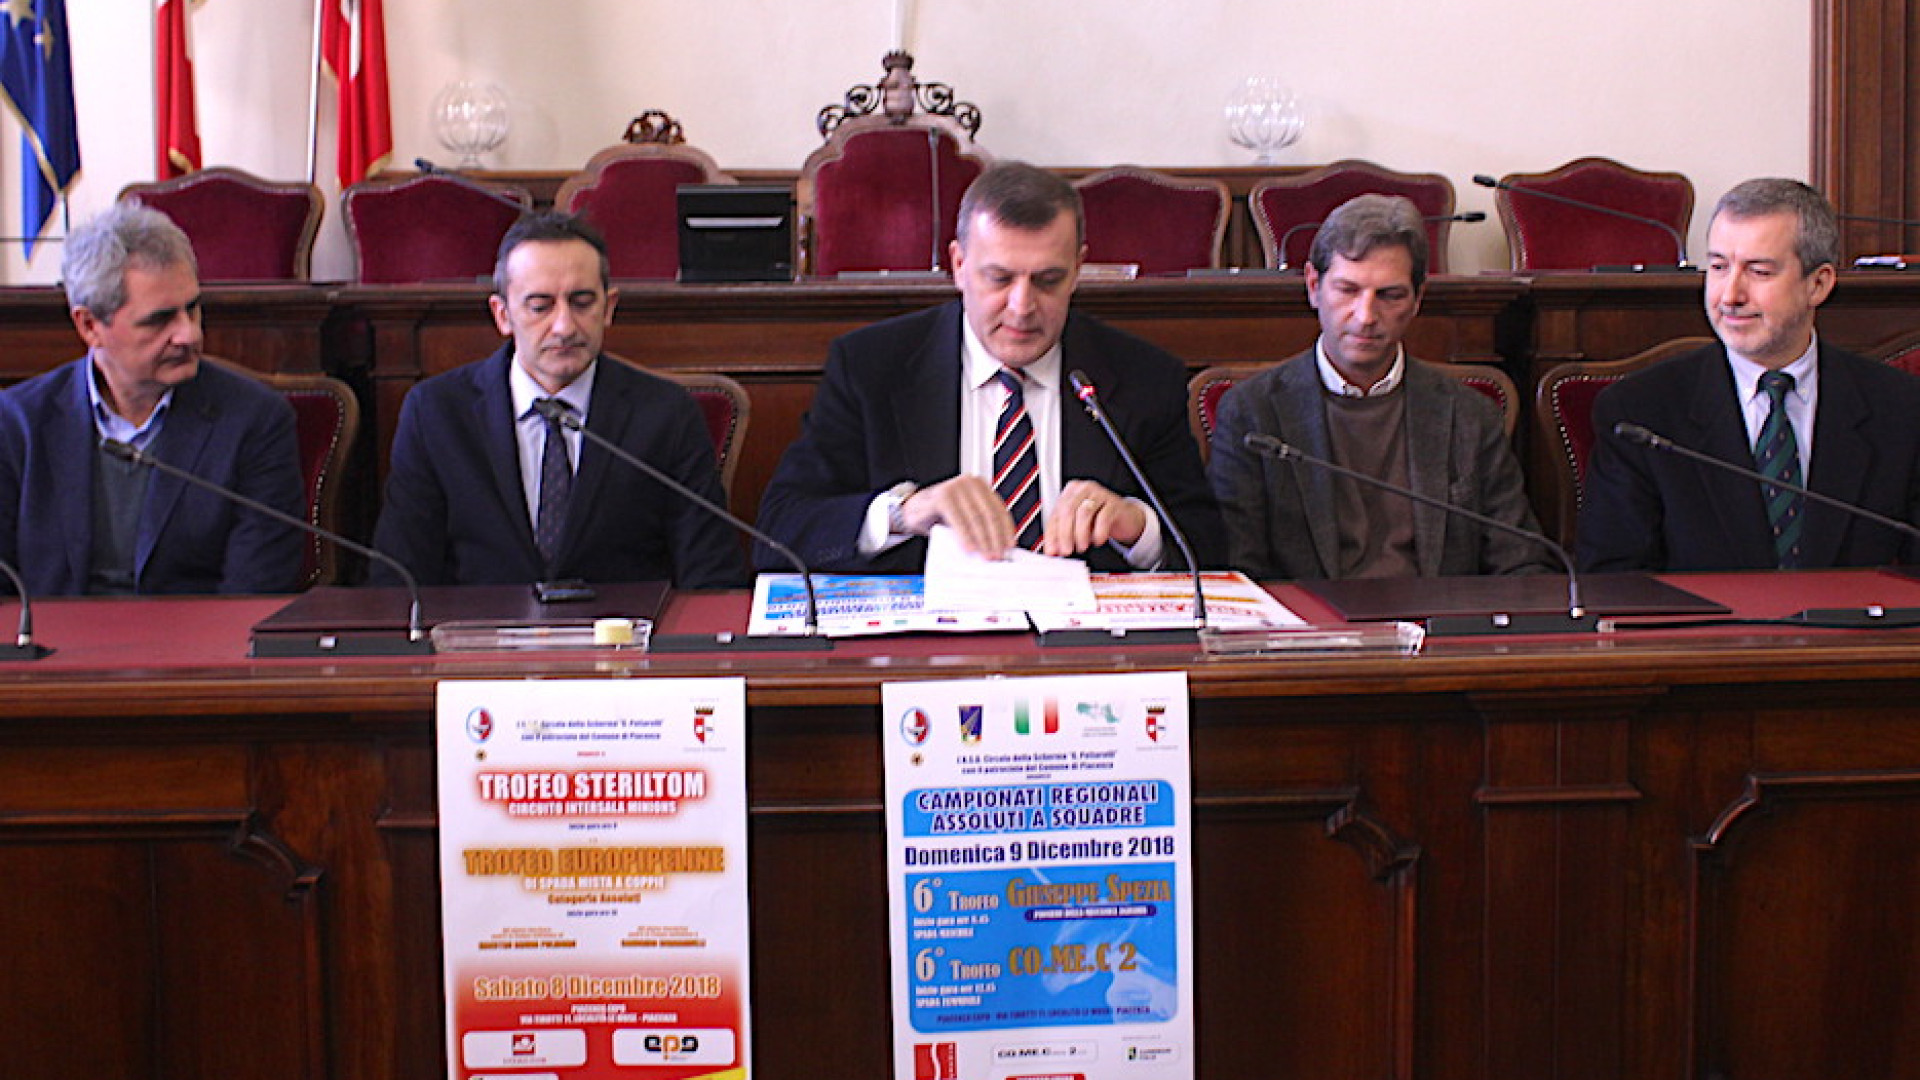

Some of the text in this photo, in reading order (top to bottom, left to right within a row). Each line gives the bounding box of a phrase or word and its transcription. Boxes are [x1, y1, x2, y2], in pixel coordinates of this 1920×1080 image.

[478, 770, 706, 799] TROFEO STERILTOM
[917, 783, 1158, 812] CAMPIONATI REGIONALI
[508, 801, 564, 815] CIRCUITO
[932, 806, 1144, 833] ASSOLUTI A SQUADRE
[463, 847, 725, 876] TROFEO EUROPIPELINE
[904, 836, 1175, 866] Domenica 9 Dicembre 2018
[539, 876, 576, 889] SPADA
[578, 876, 613, 888] MISTA
[615, 876, 623, 888] A
[625, 875, 665, 888] COPPIE
[913, 876, 943, 912] 6°
[915, 946, 945, 982] 6°
[1119, 942, 1138, 972] 2
[474, 974, 722, 999] Sabato 8 Dicembre 2018
